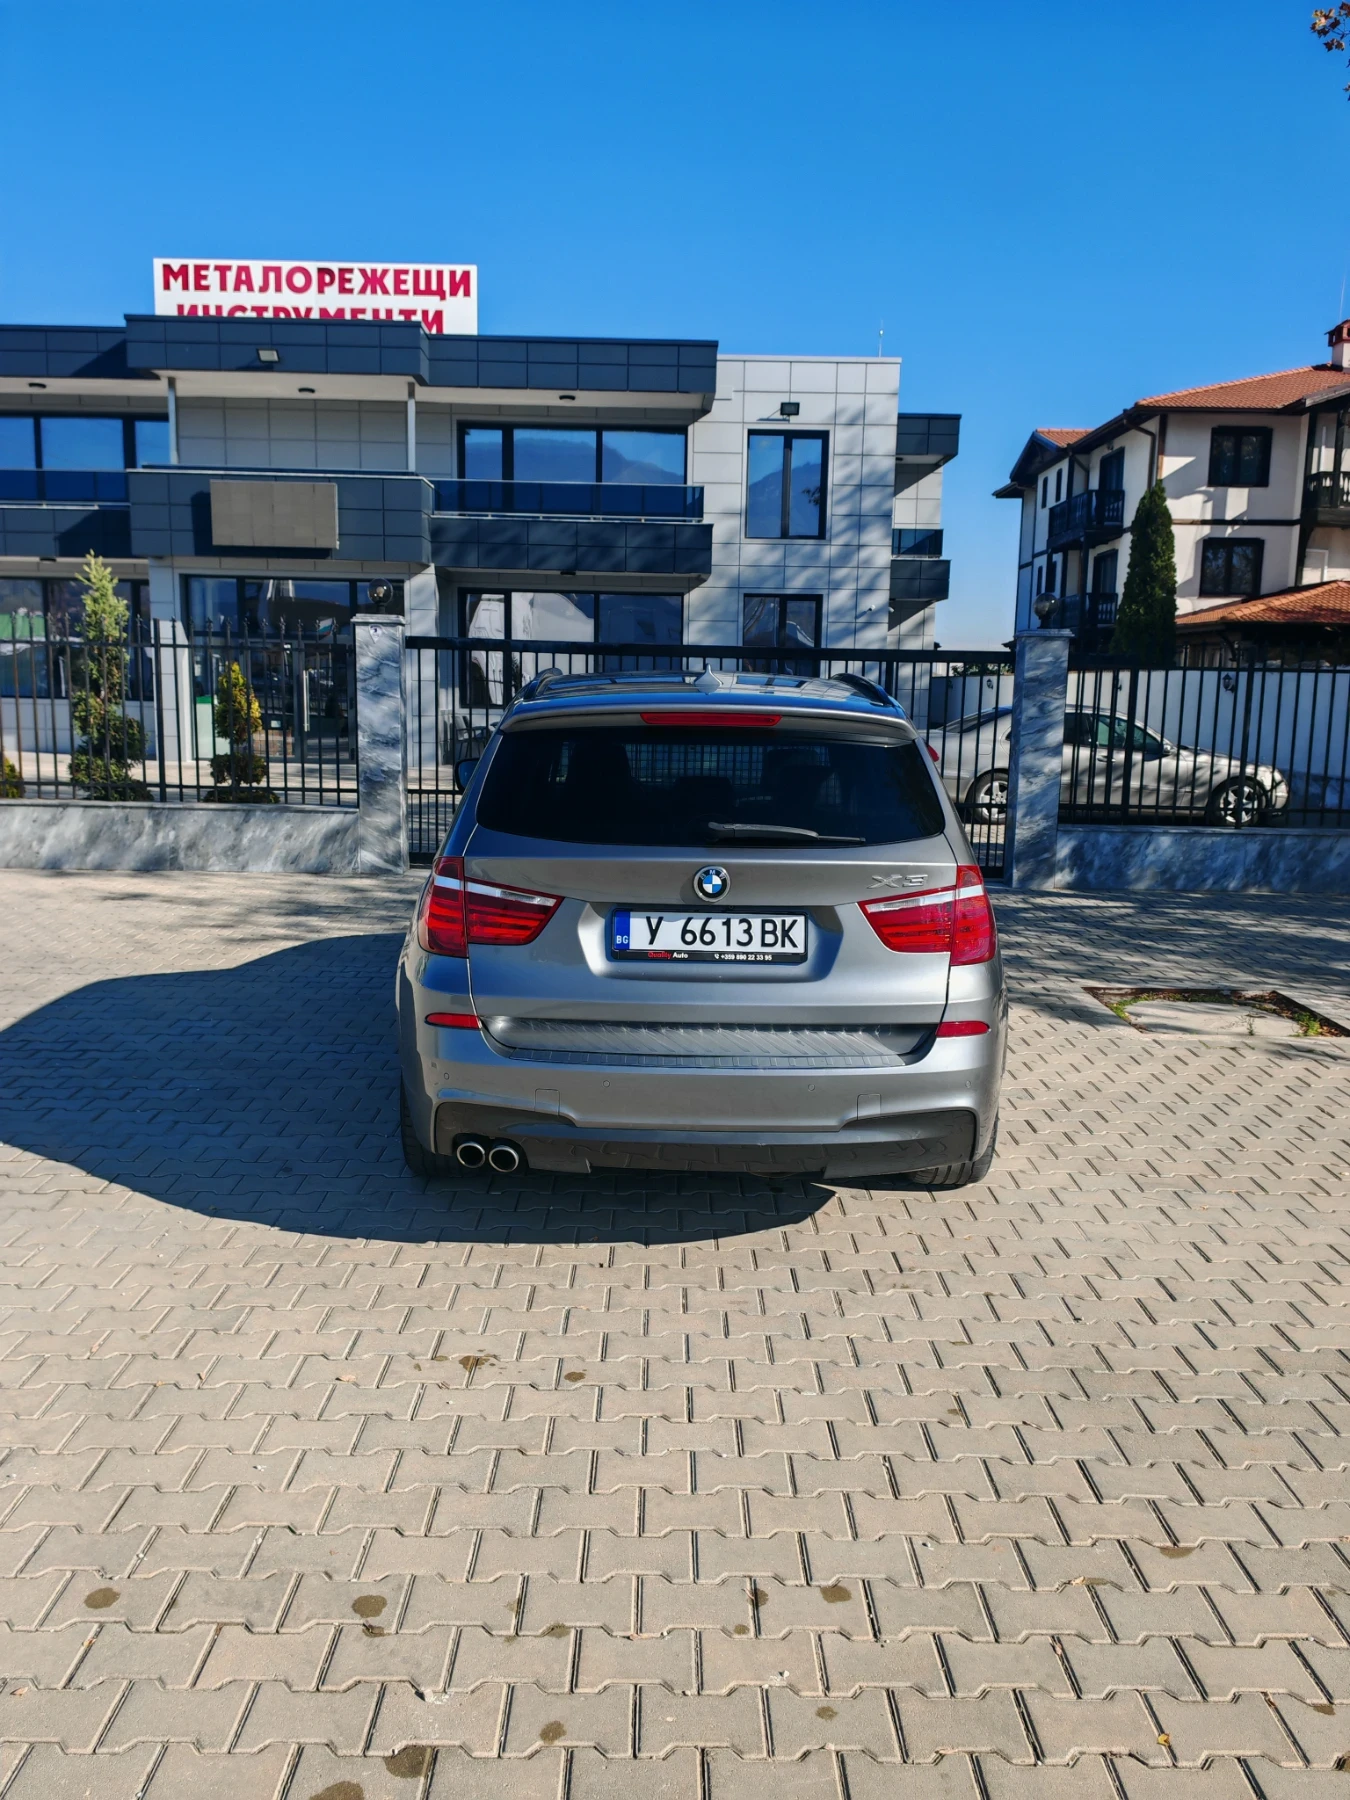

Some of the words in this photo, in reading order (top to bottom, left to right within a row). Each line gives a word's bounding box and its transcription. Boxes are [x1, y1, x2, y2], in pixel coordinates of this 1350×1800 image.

[162, 263, 471, 301] МЕТАЛОРЕЖЕЩИ
[867, 874, 928, 889] X3
[616, 935, 629, 944] BG
